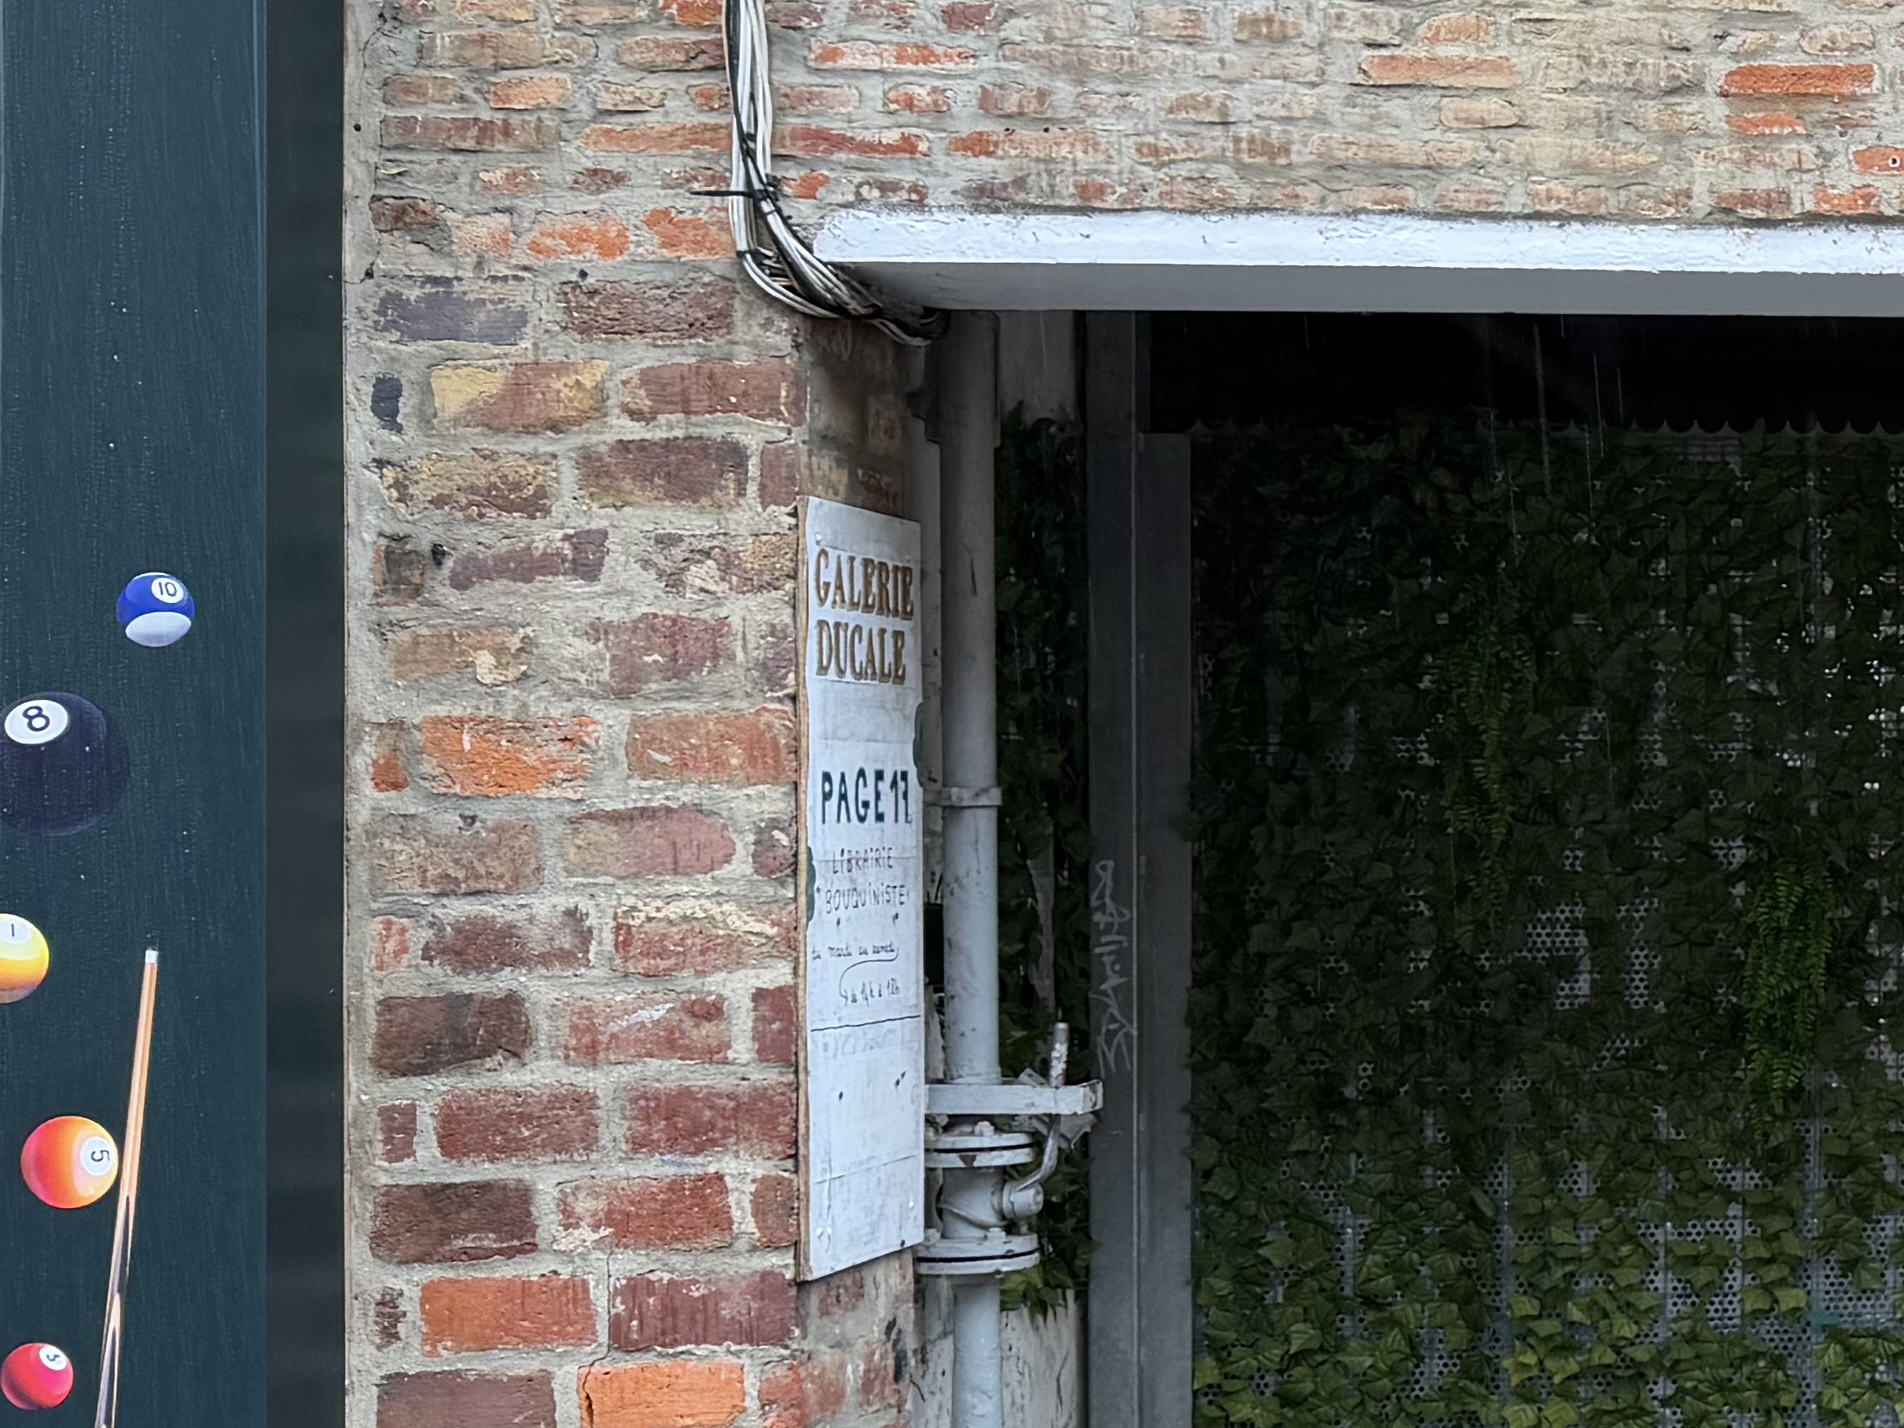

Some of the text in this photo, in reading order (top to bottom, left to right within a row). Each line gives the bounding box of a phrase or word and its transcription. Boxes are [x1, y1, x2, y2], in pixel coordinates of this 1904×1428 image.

[158, 581, 178, 598] 10
[815, 548, 914, 621] GALERIE
[816, 619, 906, 685] DUCALE
[22, 705, 51, 732] 8
[821, 766, 885, 824] PAGE
